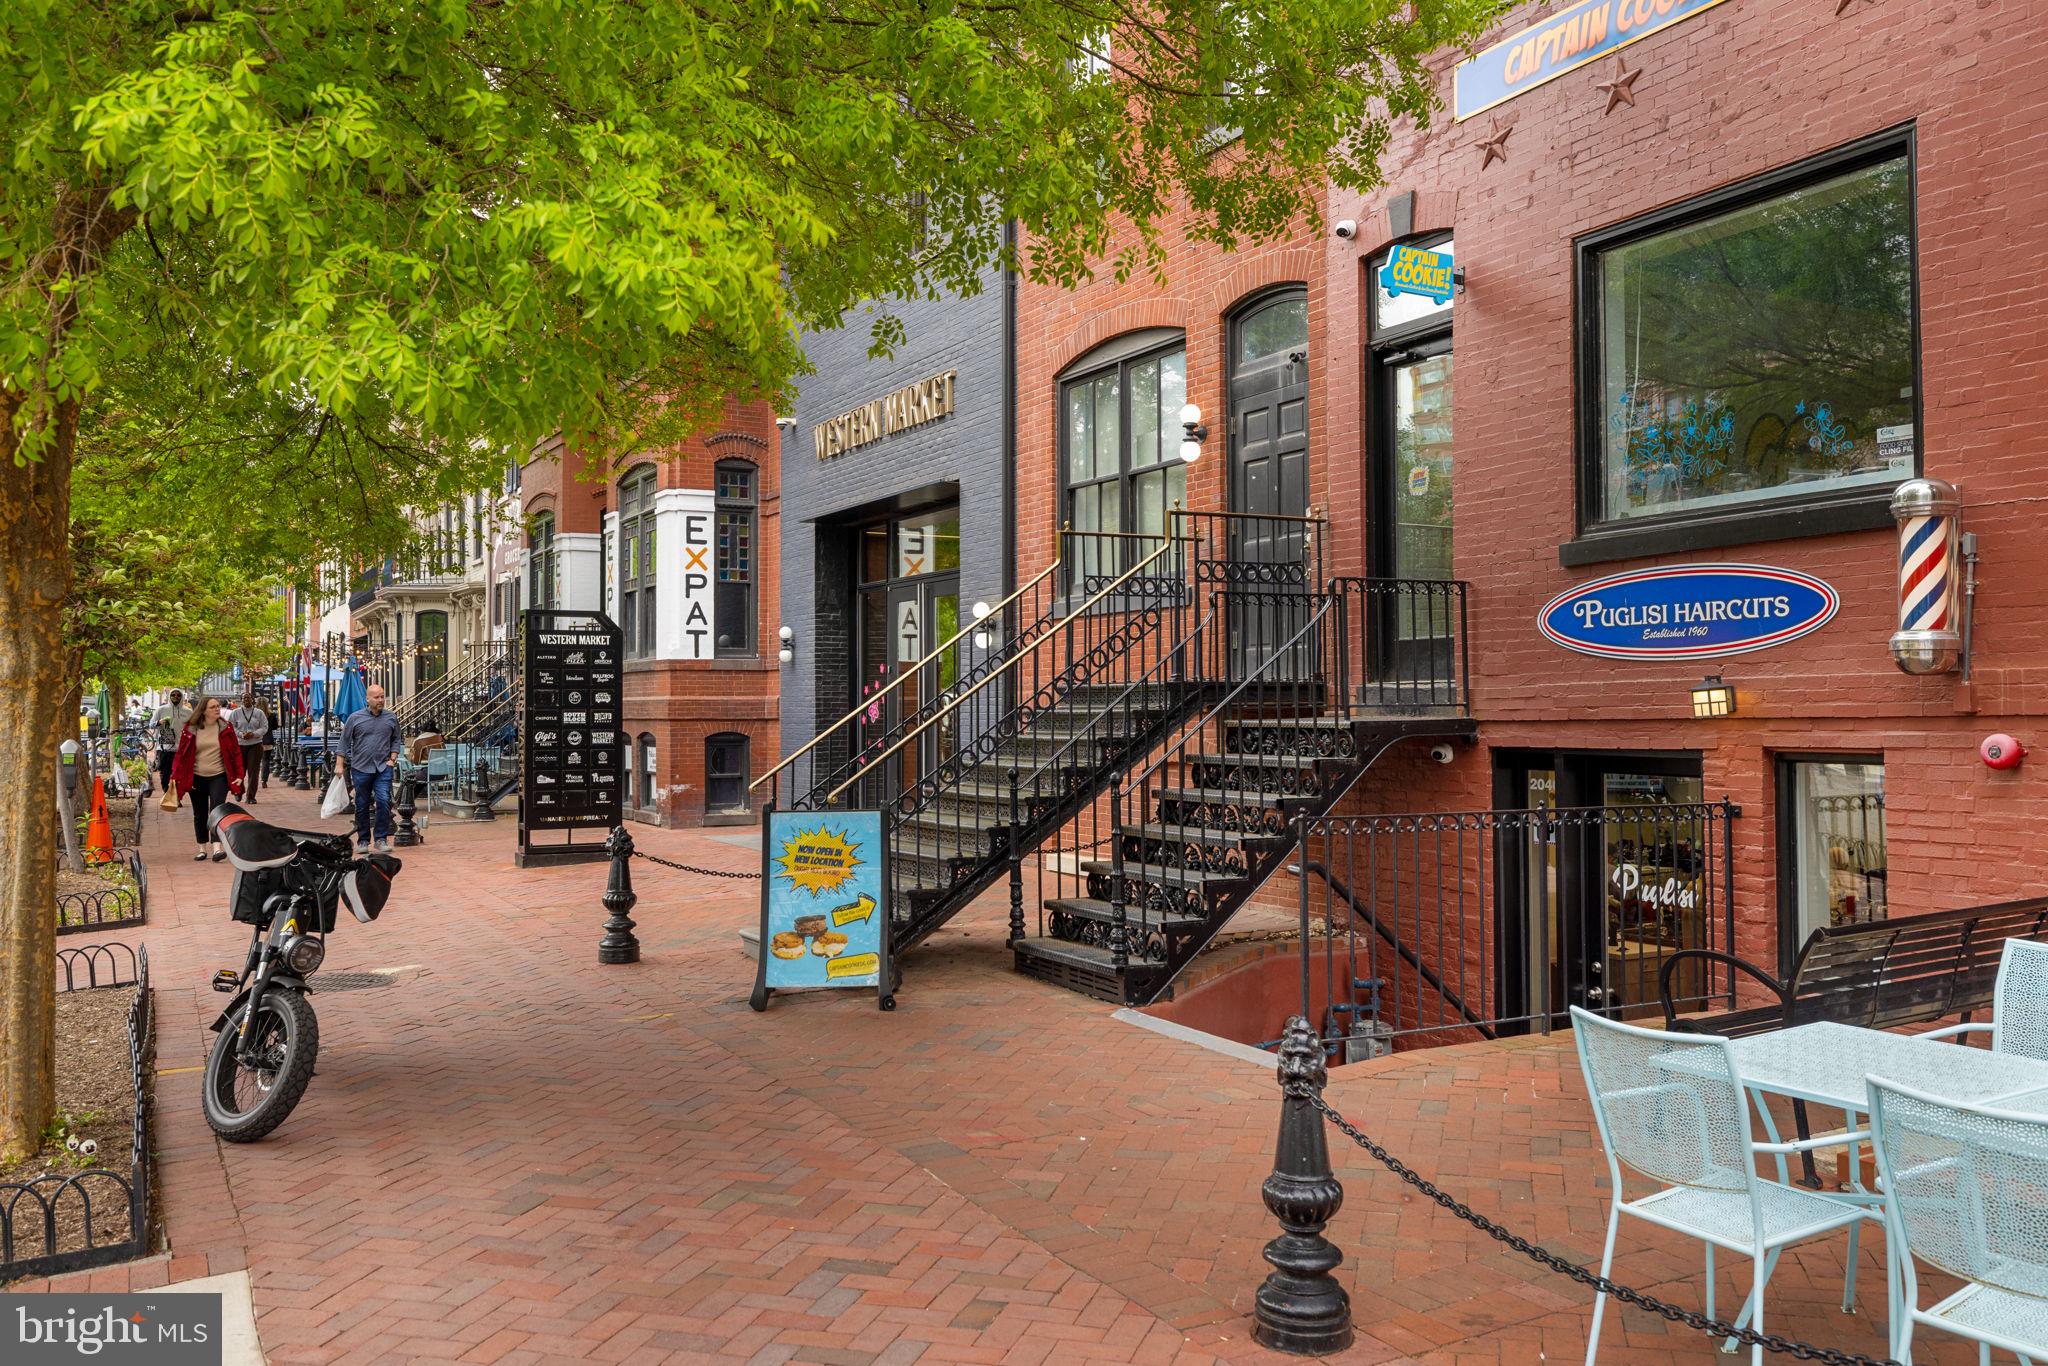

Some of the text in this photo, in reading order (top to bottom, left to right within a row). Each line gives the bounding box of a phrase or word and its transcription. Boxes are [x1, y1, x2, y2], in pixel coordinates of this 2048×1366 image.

[1504, 2, 1610, 85] CAPTAIN
[1399, 247, 1439, 266] CAPTAIN
[1393, 261, 1452, 290] COOKIE!
[815, 369, 957, 461] WESTERN MARKET
[1879, 447, 1901, 456] CLING
[684, 515, 708, 659] EXPAT
[1674, 595, 1790, 624] HAIRCUTS
[539, 634, 611, 646] WESTERN MARKET
[1642, 626, 1709, 641] Established 1960
[816, 846, 834, 856] OPEN
[794, 854, 844, 868] NEW LOCATION
